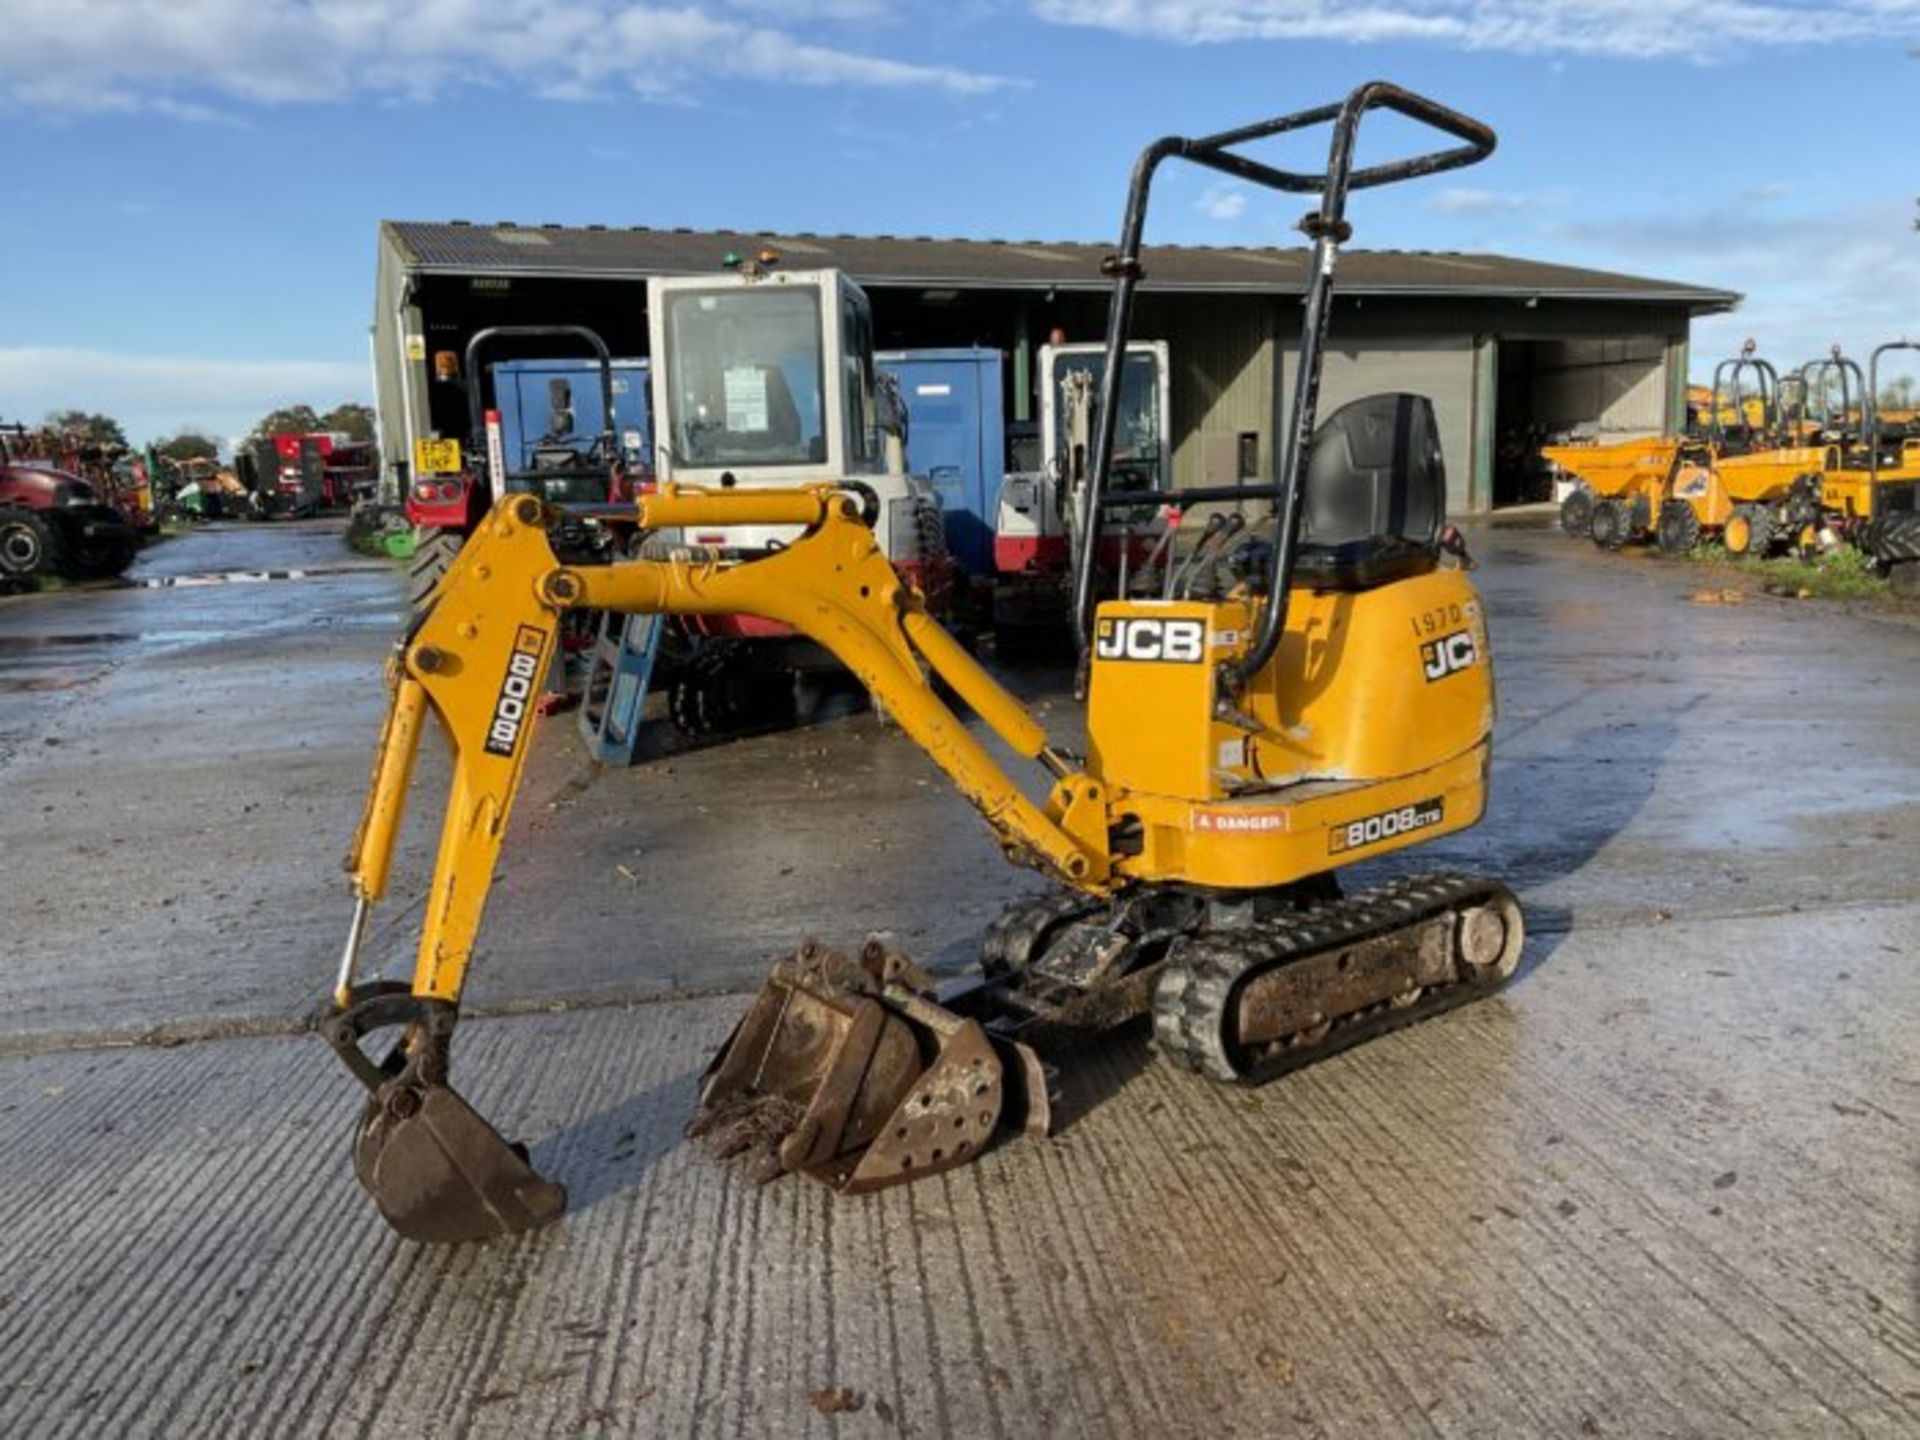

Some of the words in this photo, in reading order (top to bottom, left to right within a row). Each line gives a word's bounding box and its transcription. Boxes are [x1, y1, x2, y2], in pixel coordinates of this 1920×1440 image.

[1412, 603, 1460, 637] 1970
[1098, 619, 1203, 661] JCB
[1425, 633, 1475, 679] JC
[1216, 815, 1280, 830] DANGER
